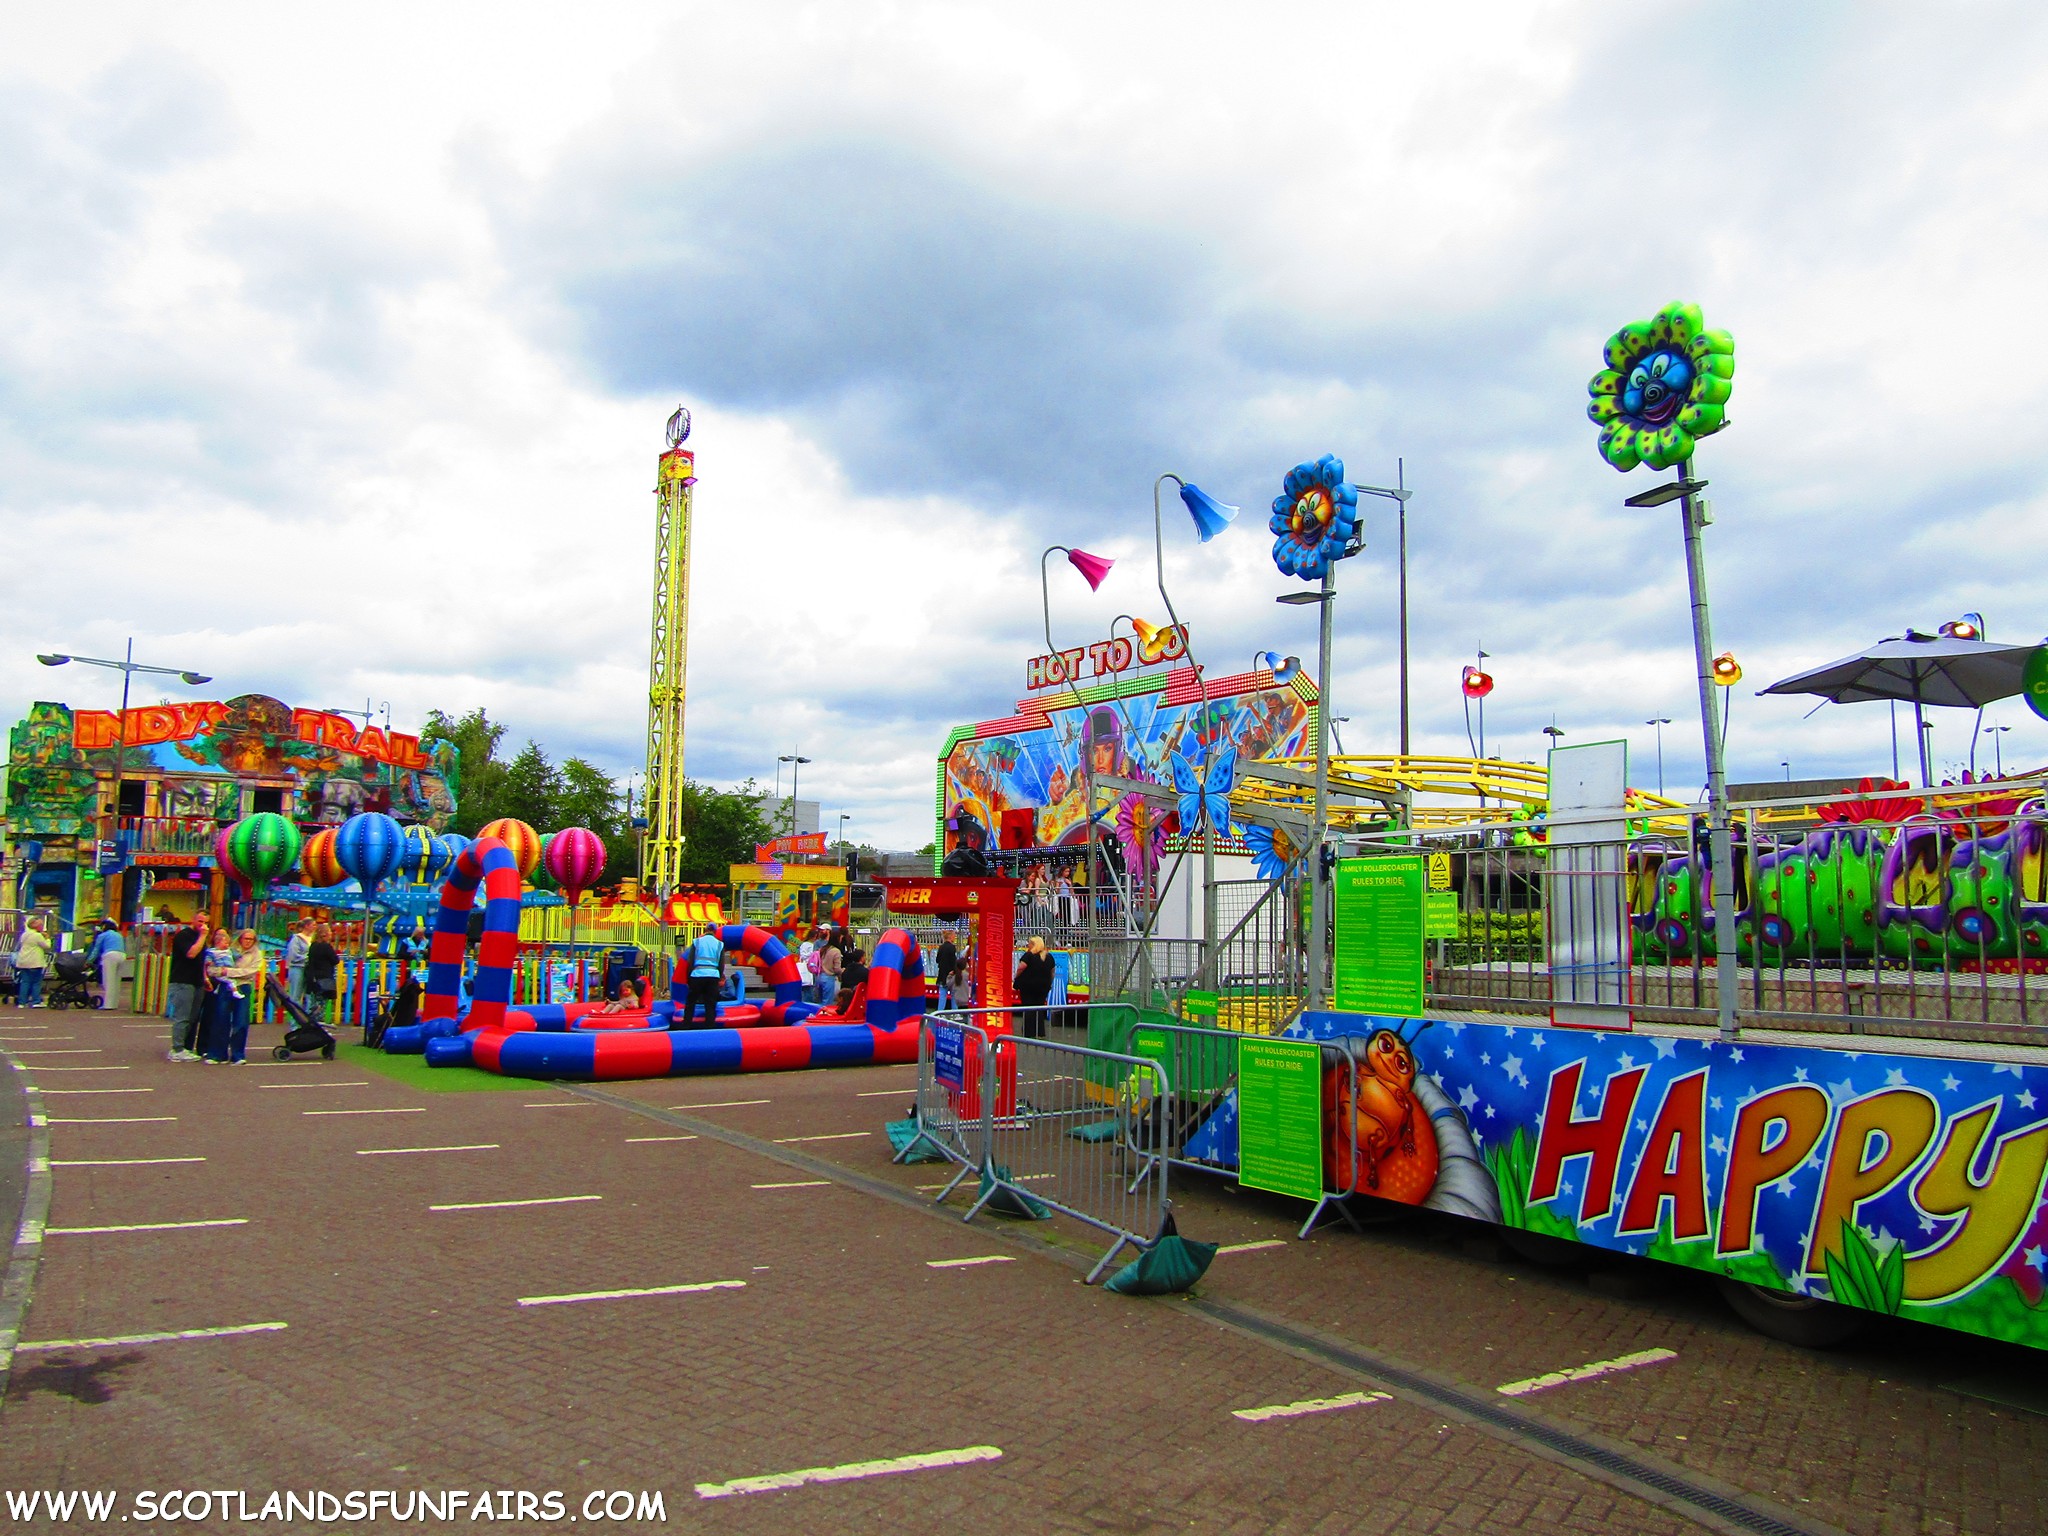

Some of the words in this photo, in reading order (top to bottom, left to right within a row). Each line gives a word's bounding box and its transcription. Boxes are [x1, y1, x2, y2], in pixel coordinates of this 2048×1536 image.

[1027, 647, 1084, 690] HOT
[1090, 637, 1132, 676] TO
[291, 707, 428, 769] TRAIL
[776, 839, 792, 851] PAY
[797, 838, 819, 850] HERE
[135, 855, 198, 866] HOUSE
[1340, 864, 1363, 873] FAMILY
[1364, 863, 1418, 872] ROLLERCOASTER
[1352, 878, 1374, 886] RULES
[985, 912, 1004, 1028] KICKPUNCHER
[1188, 999, 1216, 1007] ENTRANCE
[1139, 1039, 1164, 1047] ENTRANCE
[1243, 1045, 1264, 1053] FAMILY
[1264, 1047, 1315, 1058] ROLLERCOASTER
[1254, 1058, 1274, 1067] RULES
[1275, 1060, 1285, 1068] TO
[1285, 1061, 1303, 1071] RIDE:
[1525, 1056, 2048, 1306] HAPPY
